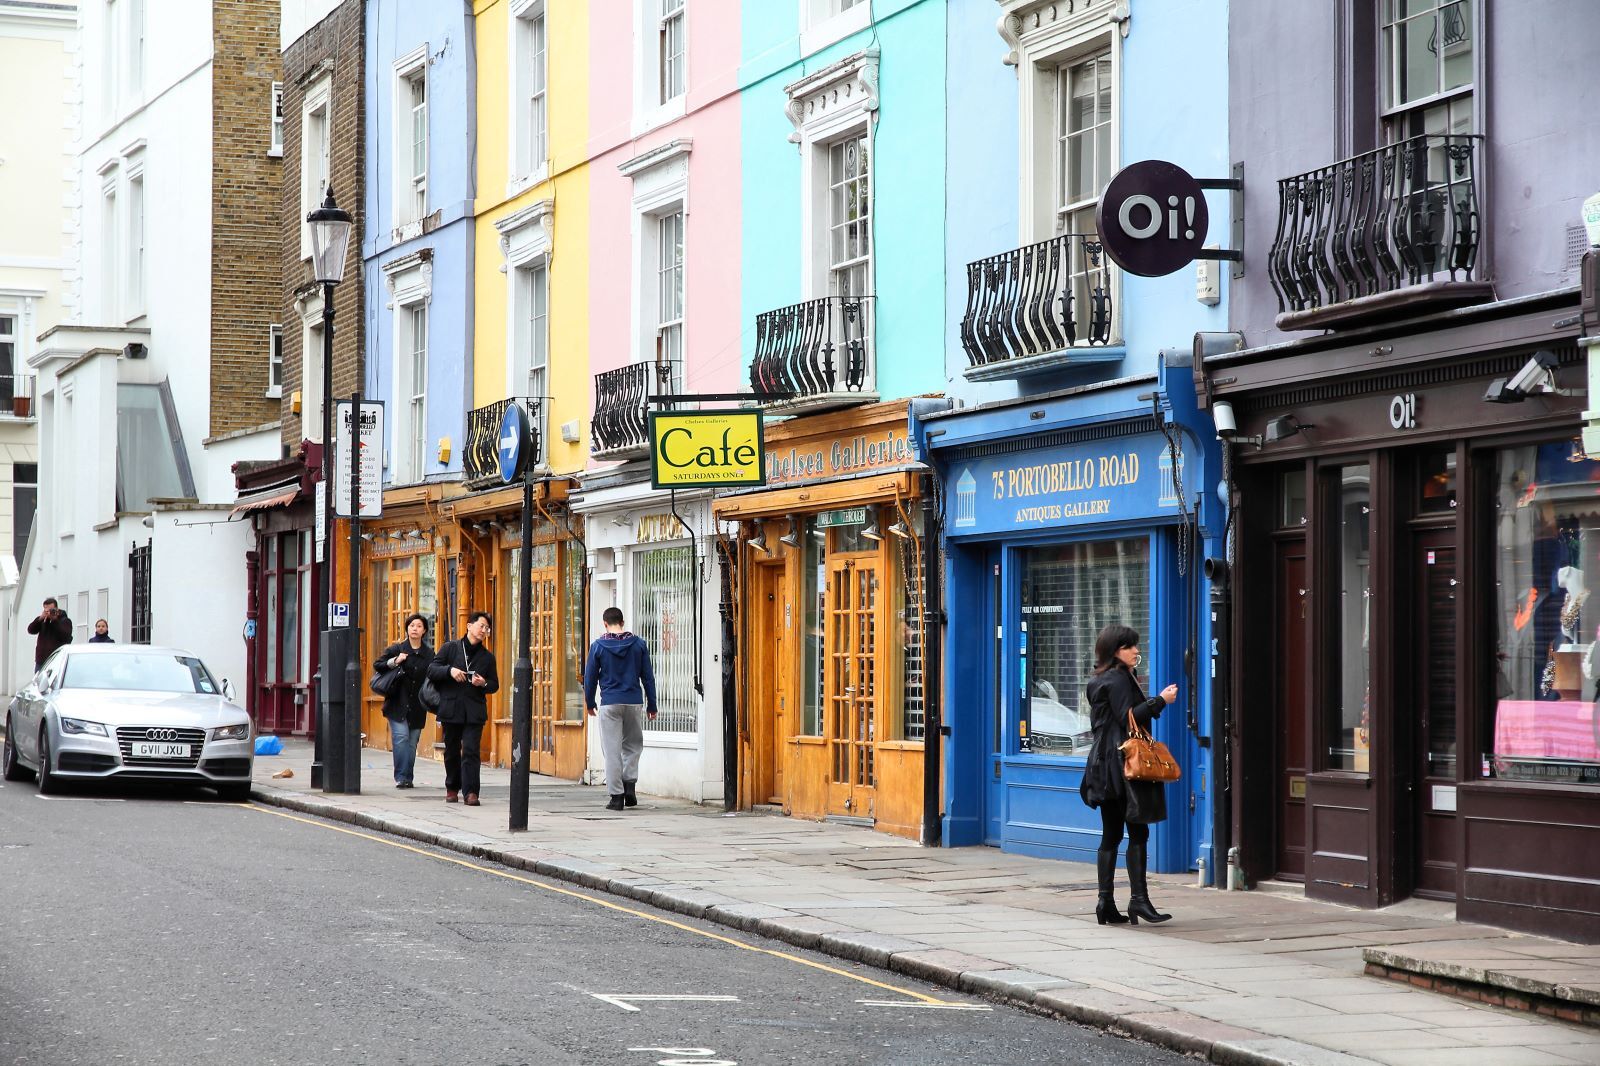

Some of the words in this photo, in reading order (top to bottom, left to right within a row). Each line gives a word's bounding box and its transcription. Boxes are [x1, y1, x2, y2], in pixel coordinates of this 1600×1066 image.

[1119, 194, 1196, 240] Oi!
[1390, 393, 1416, 428] Oi!
[660, 427, 756, 467] Café
[830, 431, 914, 470] Galleries
[992, 470, 1005, 500] 75
[1008, 458, 1095, 498] PORTOBELLO
[1098, 452, 1140, 488] ROAD
[842, 508, 865, 523] THROUGH
[1016, 505, 1061, 523] ANTIQUES
[1064, 500, 1110, 518] GALLERY
[338, 605, 346, 616] P
[141, 744, 159, 754] GV11
[163, 745, 183, 755] JXU
